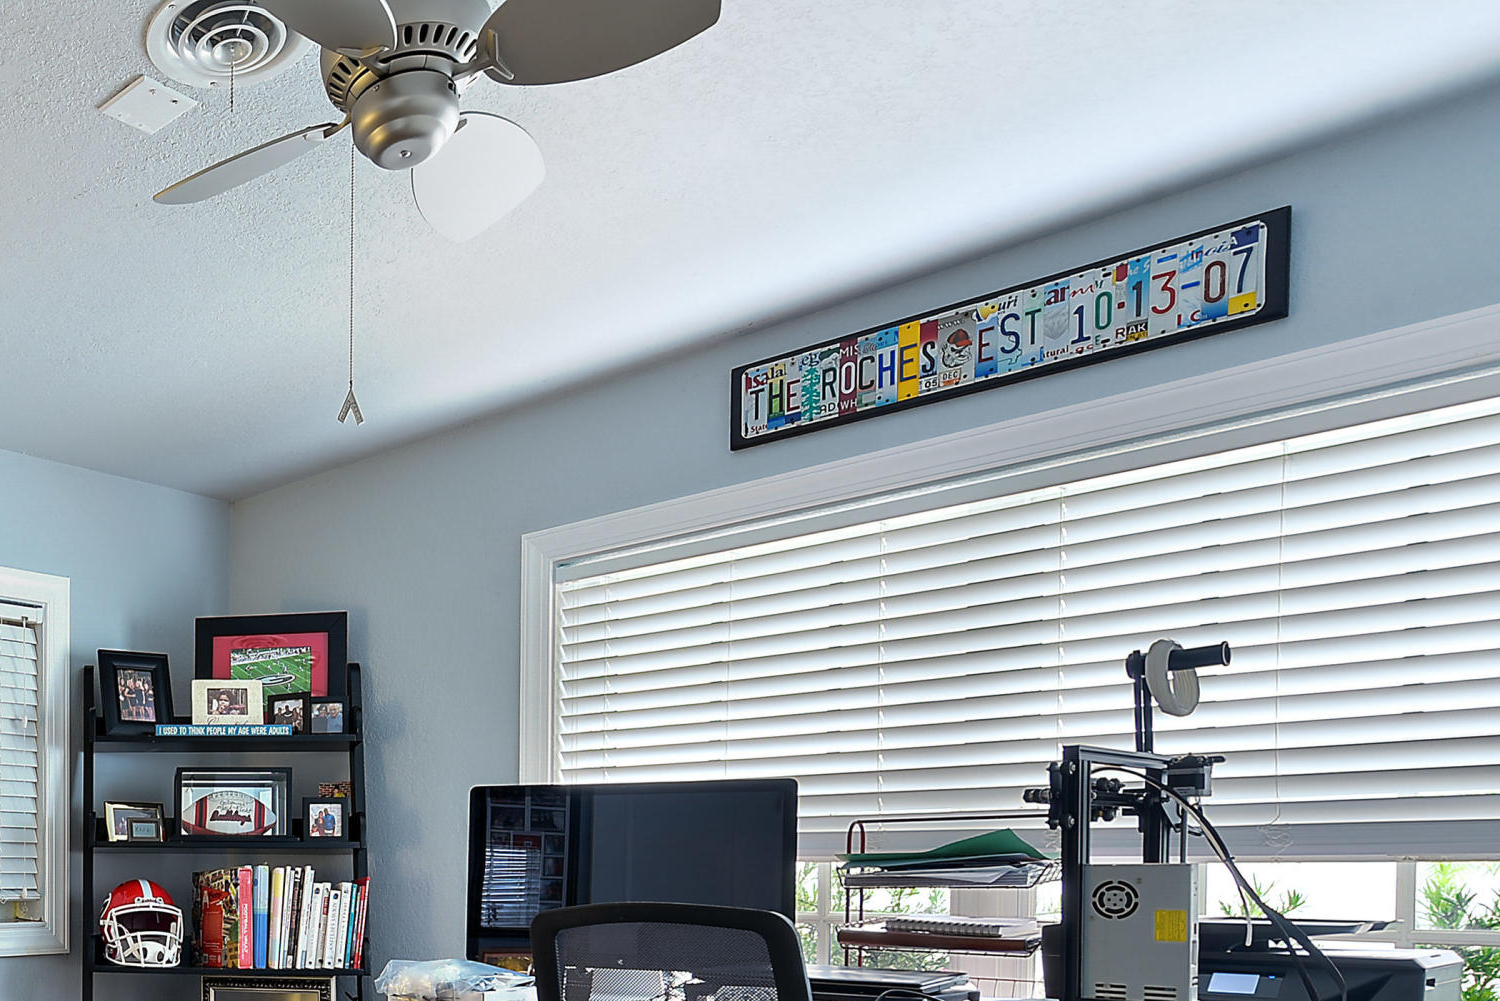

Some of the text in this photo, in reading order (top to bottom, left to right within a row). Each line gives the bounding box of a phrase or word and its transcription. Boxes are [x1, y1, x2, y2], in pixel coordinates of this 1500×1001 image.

[749, 379, 800, 421] THE
[821, 340, 937, 401] ROCHES
[978, 308, 1042, 364] EST
[163, 726, 178, 736] USED
[179, 726, 187, 736] TO
[188, 726, 205, 736] THINK
[206, 726, 226, 736] PEOPLE
[227, 726, 237, 736] MY
[238, 726, 249, 736] AGE
[251, 726, 267, 736] WERE
[268, 726, 289, 736] ADULTS
